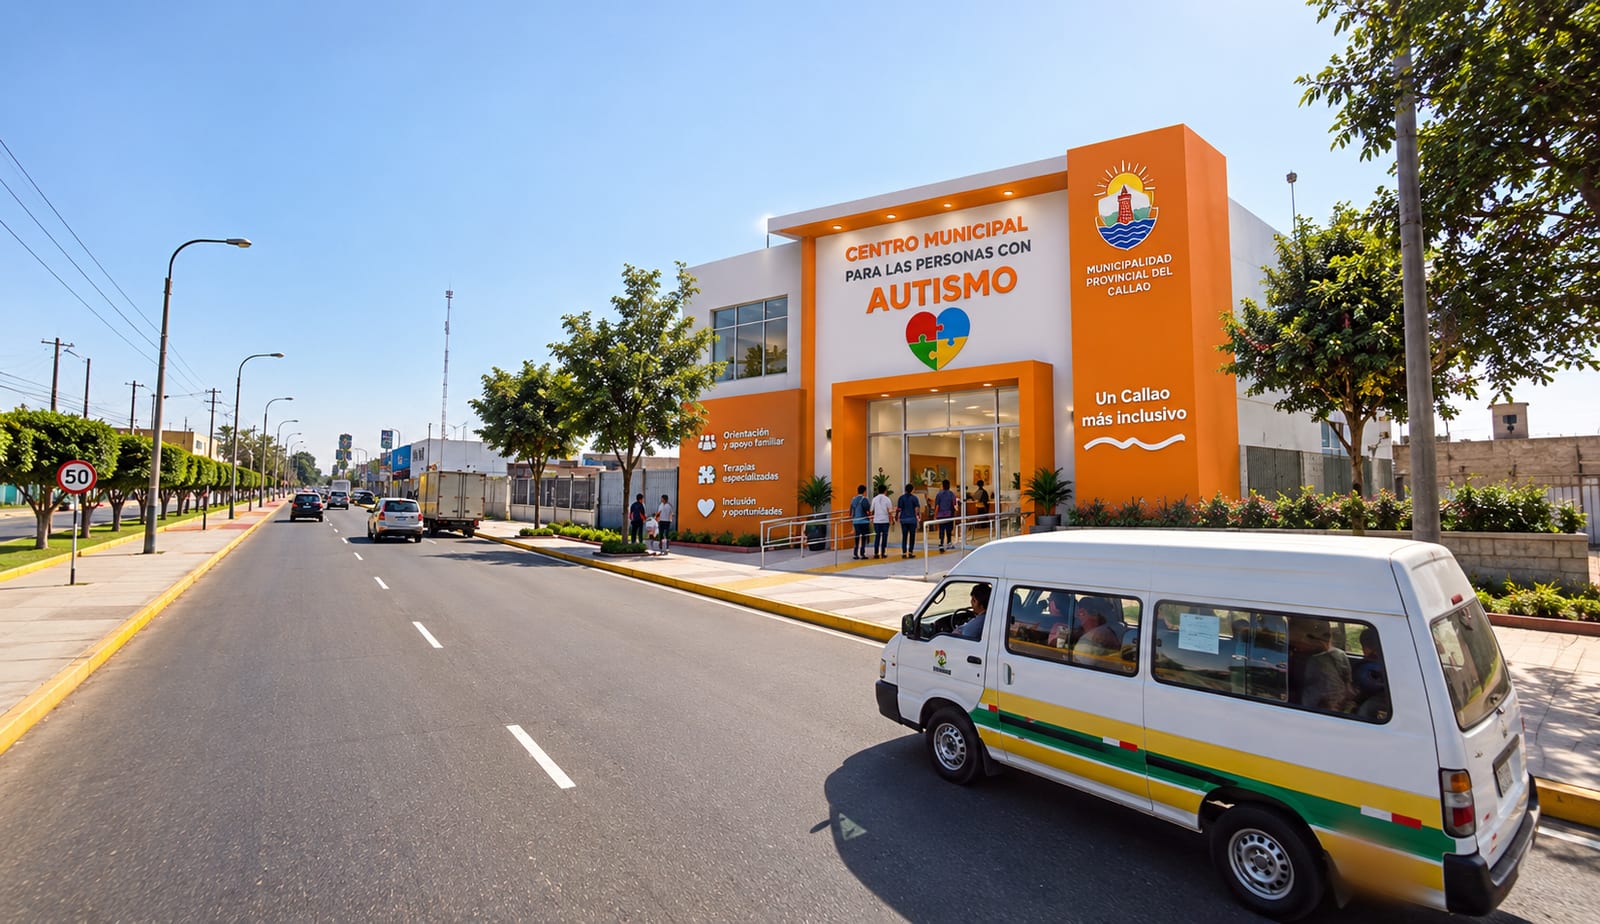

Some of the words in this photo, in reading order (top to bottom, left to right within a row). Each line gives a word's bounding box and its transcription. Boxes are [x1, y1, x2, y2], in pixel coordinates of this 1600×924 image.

[845, 235, 919, 262] CENTRO
[924, 216, 1028, 248] MUNICIPAL
[845, 267, 882, 282] PARA
[886, 260, 912, 275] LAS
[916, 247, 993, 271] PERSONAS
[997, 239, 1032, 258] CON
[1086, 253, 1173, 275] MUNICIPALIDAD
[1086, 270, 1149, 287] PROVINCIAL
[1151, 266, 1173, 278] DEL
[866, 265, 1018, 314] AUTISMO
[1107, 281, 1151, 296] CALLAO
[1095, 391, 1117, 406] Un
[1120, 386, 1171, 403] Callao
[1081, 411, 1113, 427] más
[1117, 406, 1187, 425] inclusivo
[723, 428, 769, 439] Orientación
[722, 442, 729, 451] y
[729, 440, 753, 450] apoyo
[754, 437, 785, 447] familiar
[723, 463, 756, 473] Terapias
[65, 469, 89, 484] 50
[722, 472, 779, 483] especializadas
[722, 497, 757, 505] Inclusión
[722, 509, 728, 518] y
[728, 507, 783, 517] oportunidades
